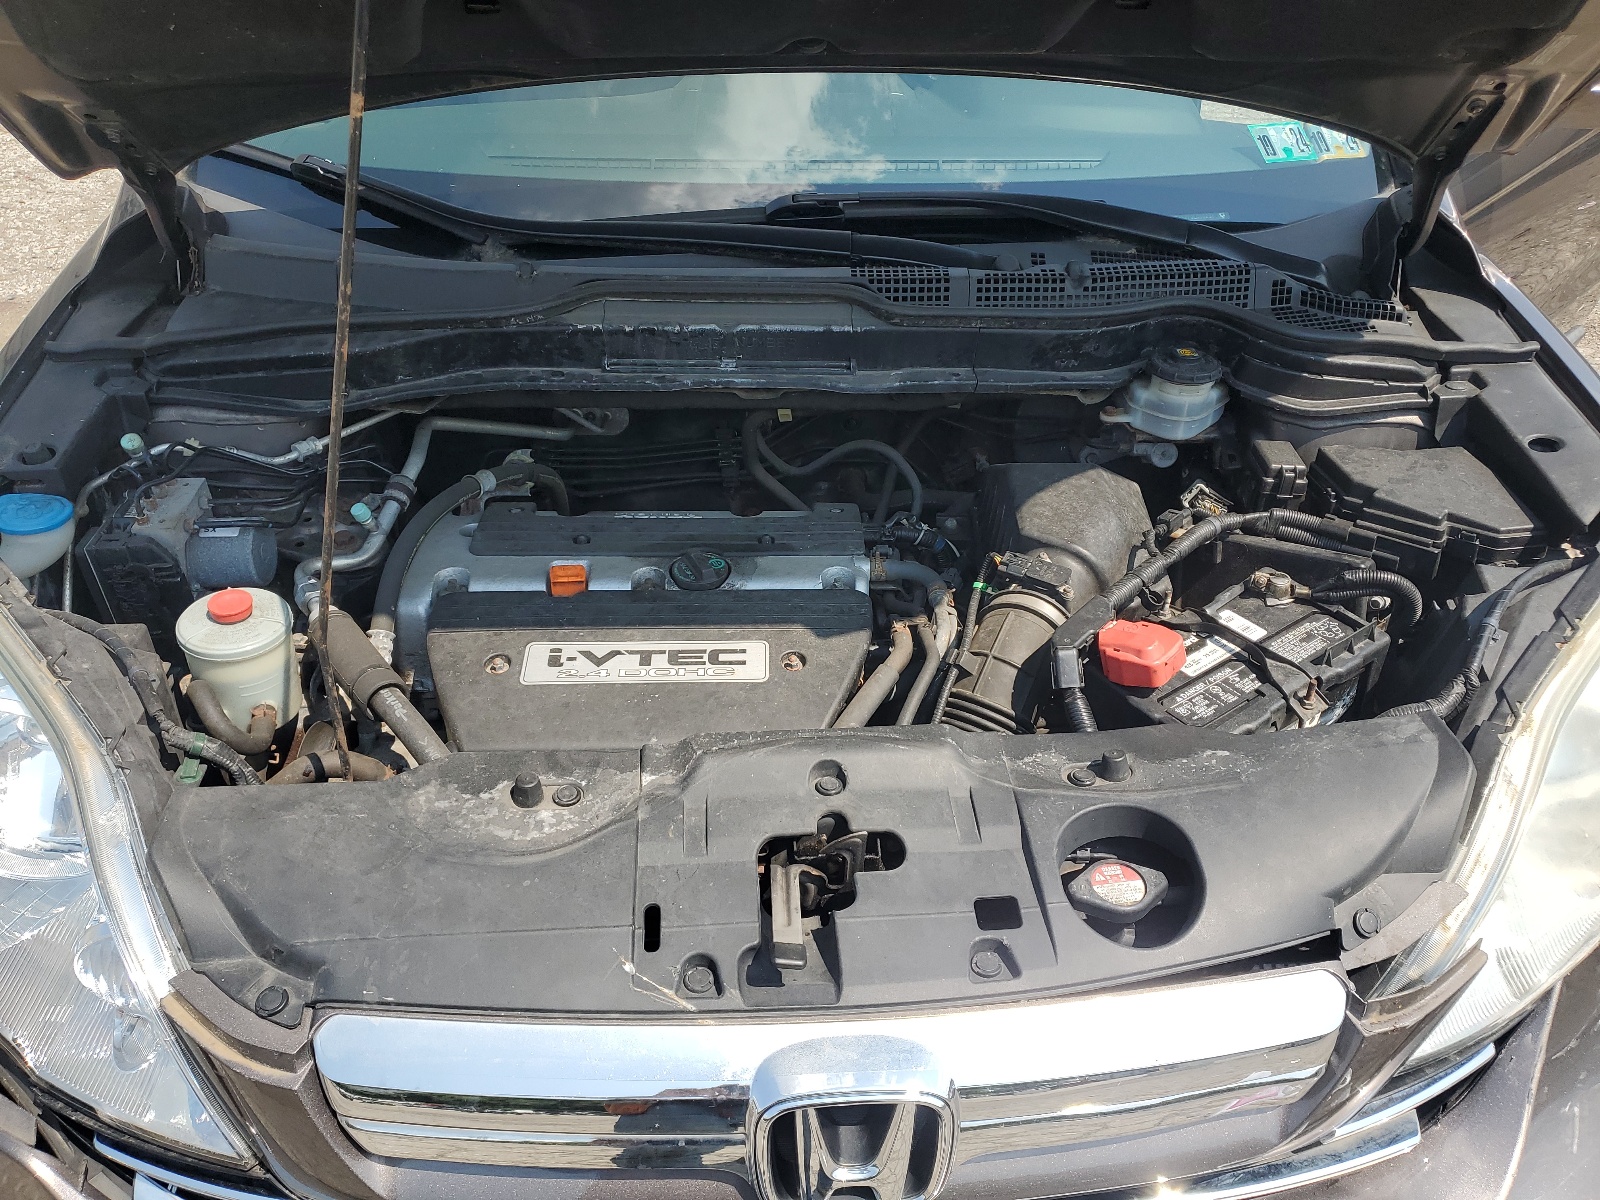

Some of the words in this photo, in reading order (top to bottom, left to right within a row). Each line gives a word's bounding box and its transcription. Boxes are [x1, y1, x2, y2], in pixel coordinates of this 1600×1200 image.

[1288, 126, 1312, 154] 24
[547, 647, 747, 668] i-VTEC
[557, 667, 611, 679] 2.4
[617, 667, 736, 678] DOHC
[380, 689, 408, 722] Parker
